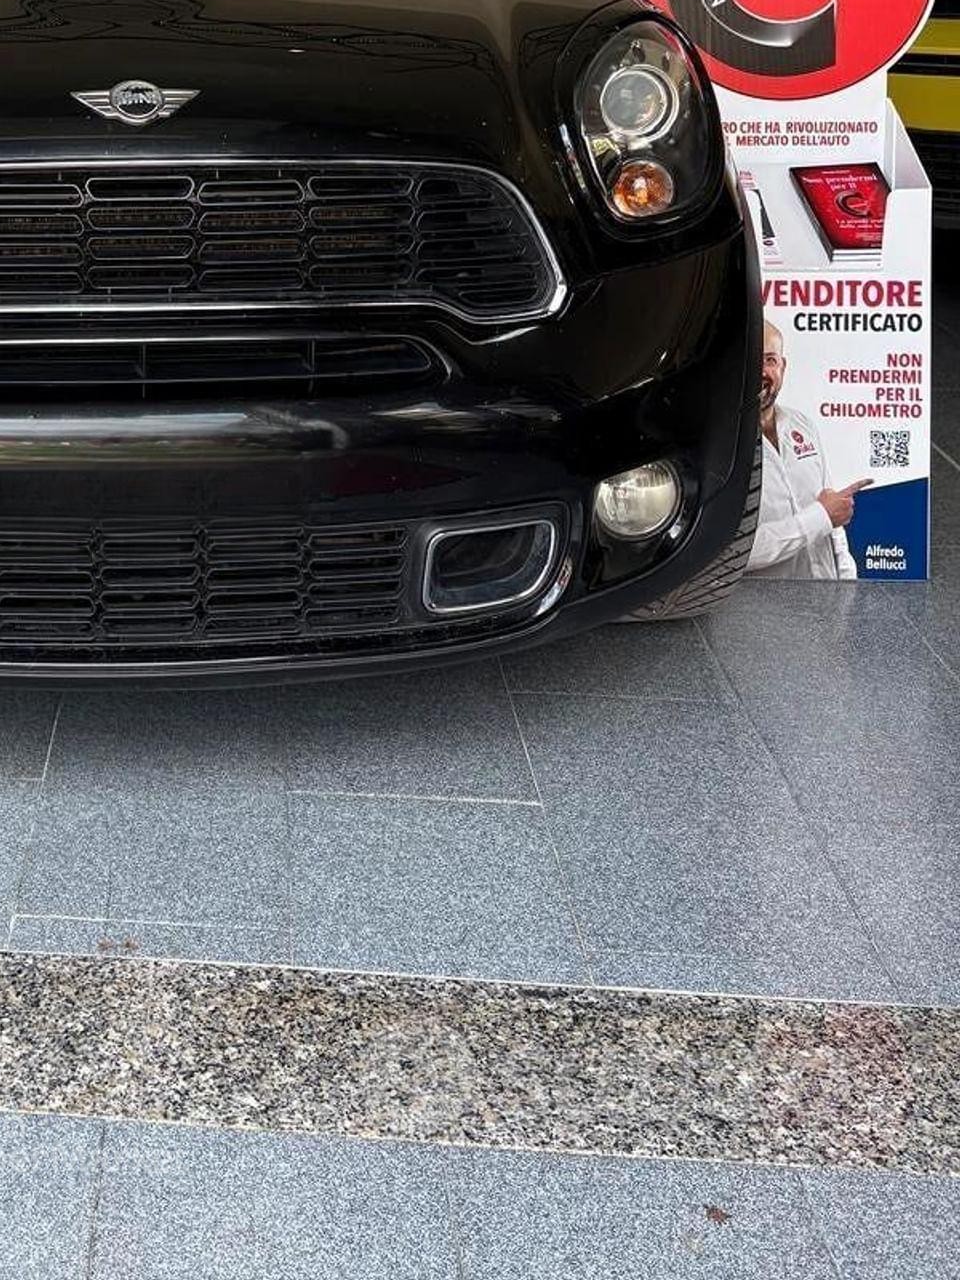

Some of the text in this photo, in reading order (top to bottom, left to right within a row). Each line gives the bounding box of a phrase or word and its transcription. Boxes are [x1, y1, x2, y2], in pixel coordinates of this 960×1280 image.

[740, 121, 762, 133] CHE
[765, 121, 781, 133] HA
[786, 121, 878, 134] RIVOLUZIONATO
[736, 135, 789, 146] MERCATO
[792, 135, 850, 146] DELL'AUTO
[761, 280, 923, 307] VENDITORE
[793, 312, 923, 332] CERTIFICATO
[887, 353, 922, 367] NON
[829, 370, 922, 384] PRENDERMI
[876, 388, 922, 401] PER IL
[820, 403, 922, 418] CHILOMETRO
[865, 545, 904, 557] Alfredo
[866, 558, 906, 570] Bellucci
